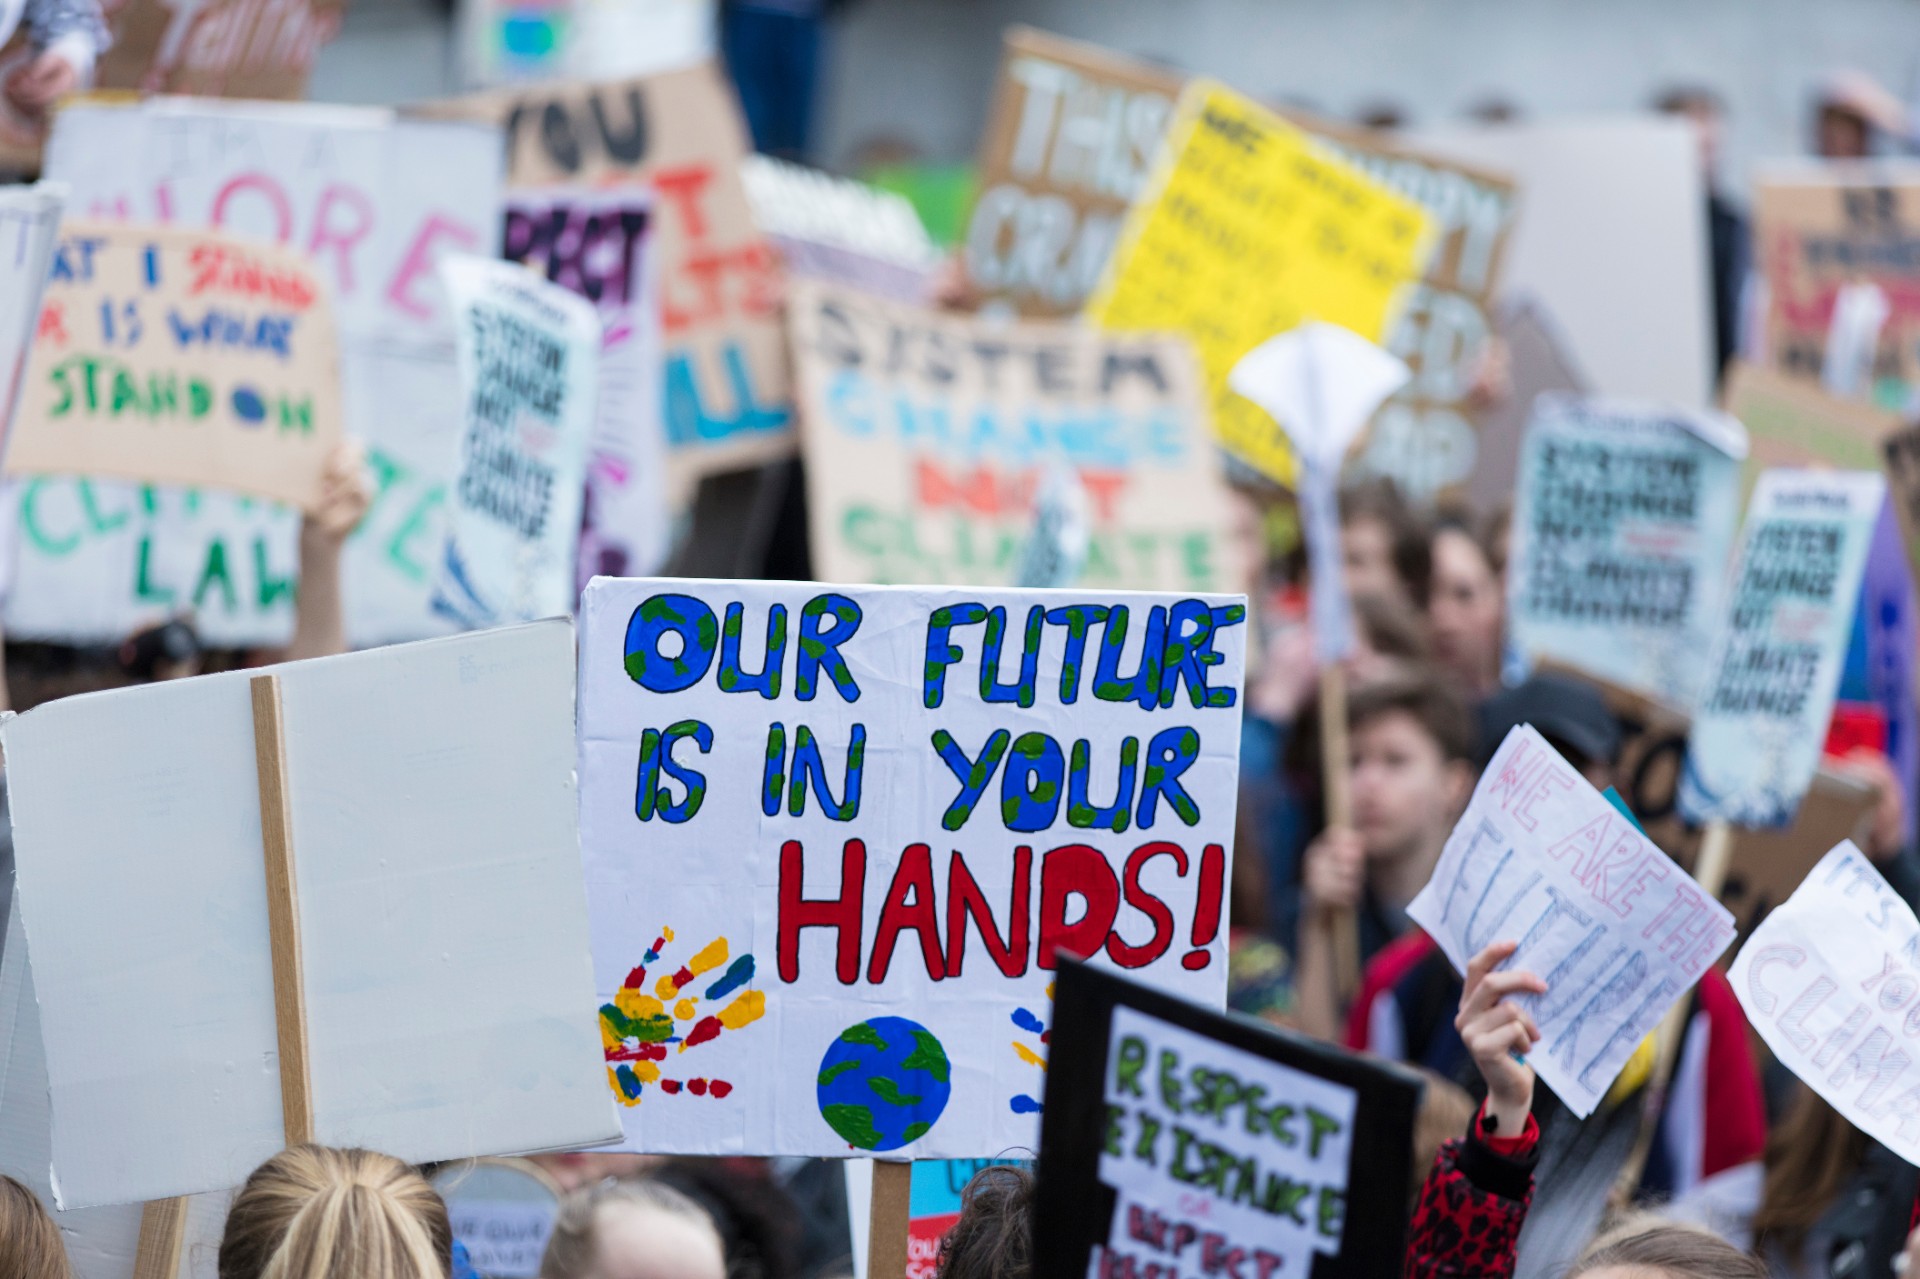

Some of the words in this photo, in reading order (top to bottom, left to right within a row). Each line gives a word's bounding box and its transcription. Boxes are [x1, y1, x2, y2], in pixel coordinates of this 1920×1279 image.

[48, 352, 214, 424] STAND
[623, 593, 862, 703] OUR
[923, 598, 1246, 711] FUTURE
[635, 719, 714, 824] IS
[761, 721, 866, 822] IN
[931, 725, 1201, 833] YOUR
[776, 838, 1226, 985] HANDS!
[1488, 737, 1578, 834] WE
[1546, 811, 1671, 921] ARE
[1640, 883, 1733, 978] THE
[1116, 1034, 1342, 1160] RESPECT
